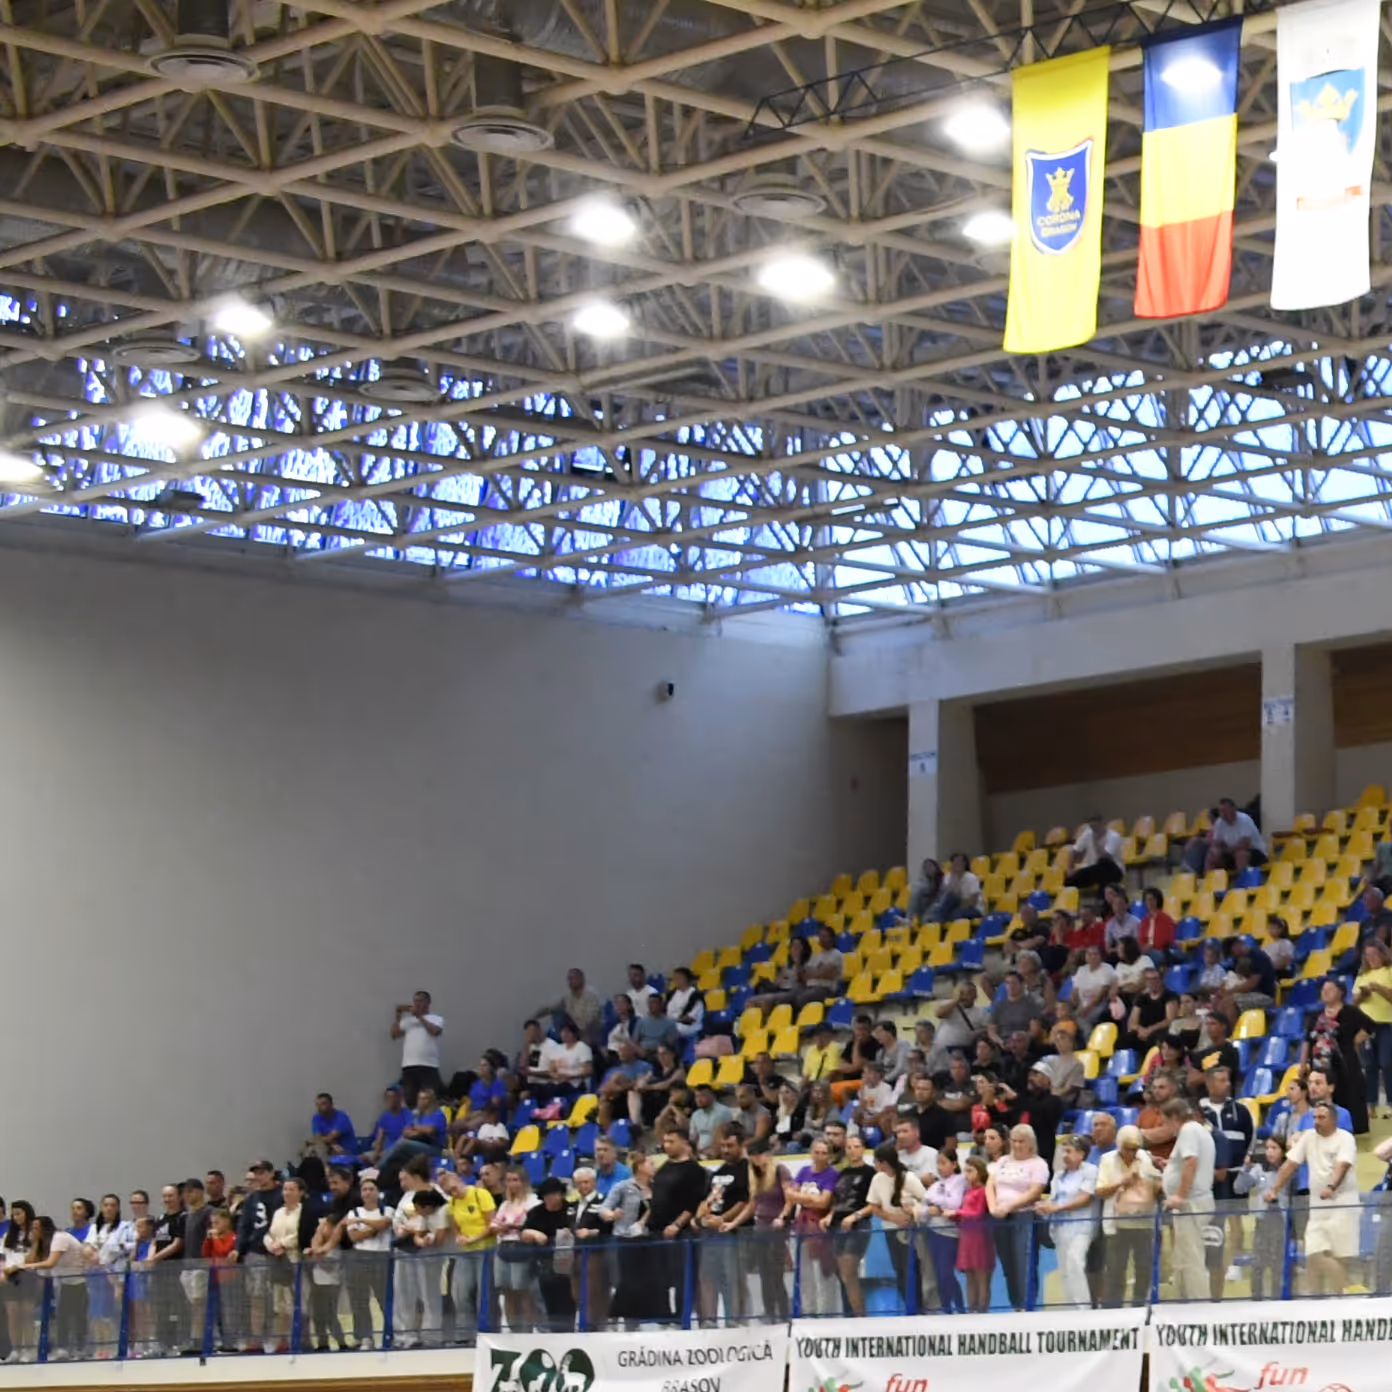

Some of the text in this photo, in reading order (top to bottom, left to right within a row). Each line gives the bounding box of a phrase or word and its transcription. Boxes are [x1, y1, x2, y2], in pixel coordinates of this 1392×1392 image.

[795, 1327, 1139, 1359] YOUTH INTERNATIONAL HANDBALL TOURNAMENT
[1156, 1322, 1208, 1347] YOUTH
[1213, 1319, 1336, 1346] INTERNATIONAL
[1256, 1361, 1309, 1389] fun
